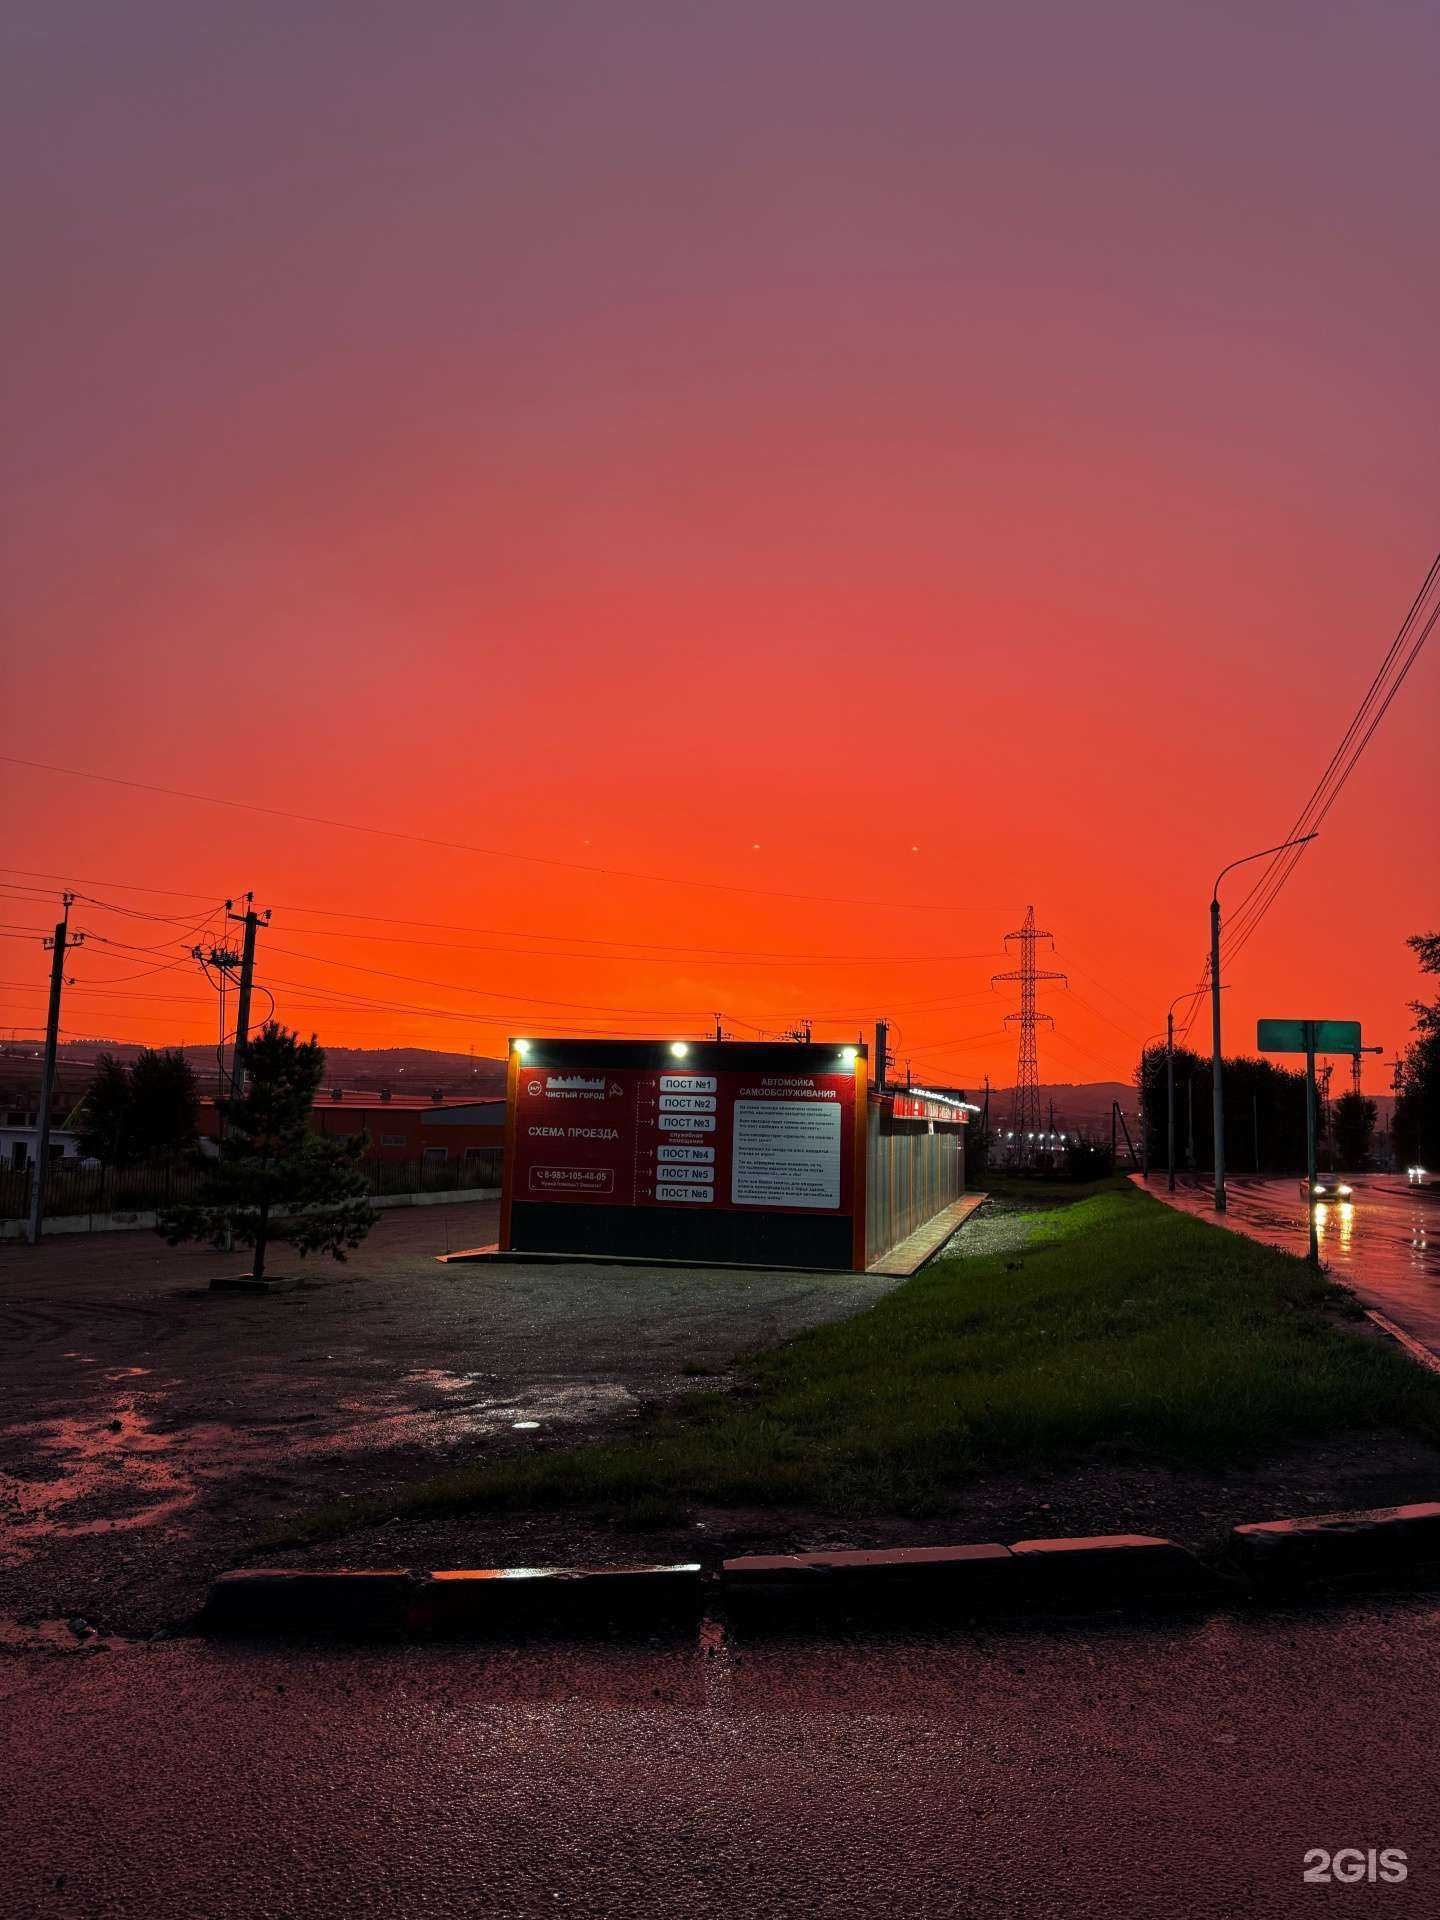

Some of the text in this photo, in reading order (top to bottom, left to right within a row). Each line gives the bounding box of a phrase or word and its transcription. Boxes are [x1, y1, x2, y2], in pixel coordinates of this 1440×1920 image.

[665, 1079, 712, 1089] ПОСТ №1
[761, 1077, 815, 1087] АВТОМОЙКА
[545, 1090, 605, 1100] ЧИСТЫЙ ГОРОД
[739, 1088, 837, 1098] САМООБСЛУЖИВАНИЯ
[664, 1098, 711, 1109] ПОСТ №2
[664, 1118, 710, 1128] ПОСТ №3
[528, 1126, 619, 1140] СХЕМА ПРОЕЗДА
[662, 1149, 709, 1160] ПОСТ №4
[662, 1168, 709, 1179] ПОСТ №5
[661, 1188, 708, 1199] ПОСТ №6
